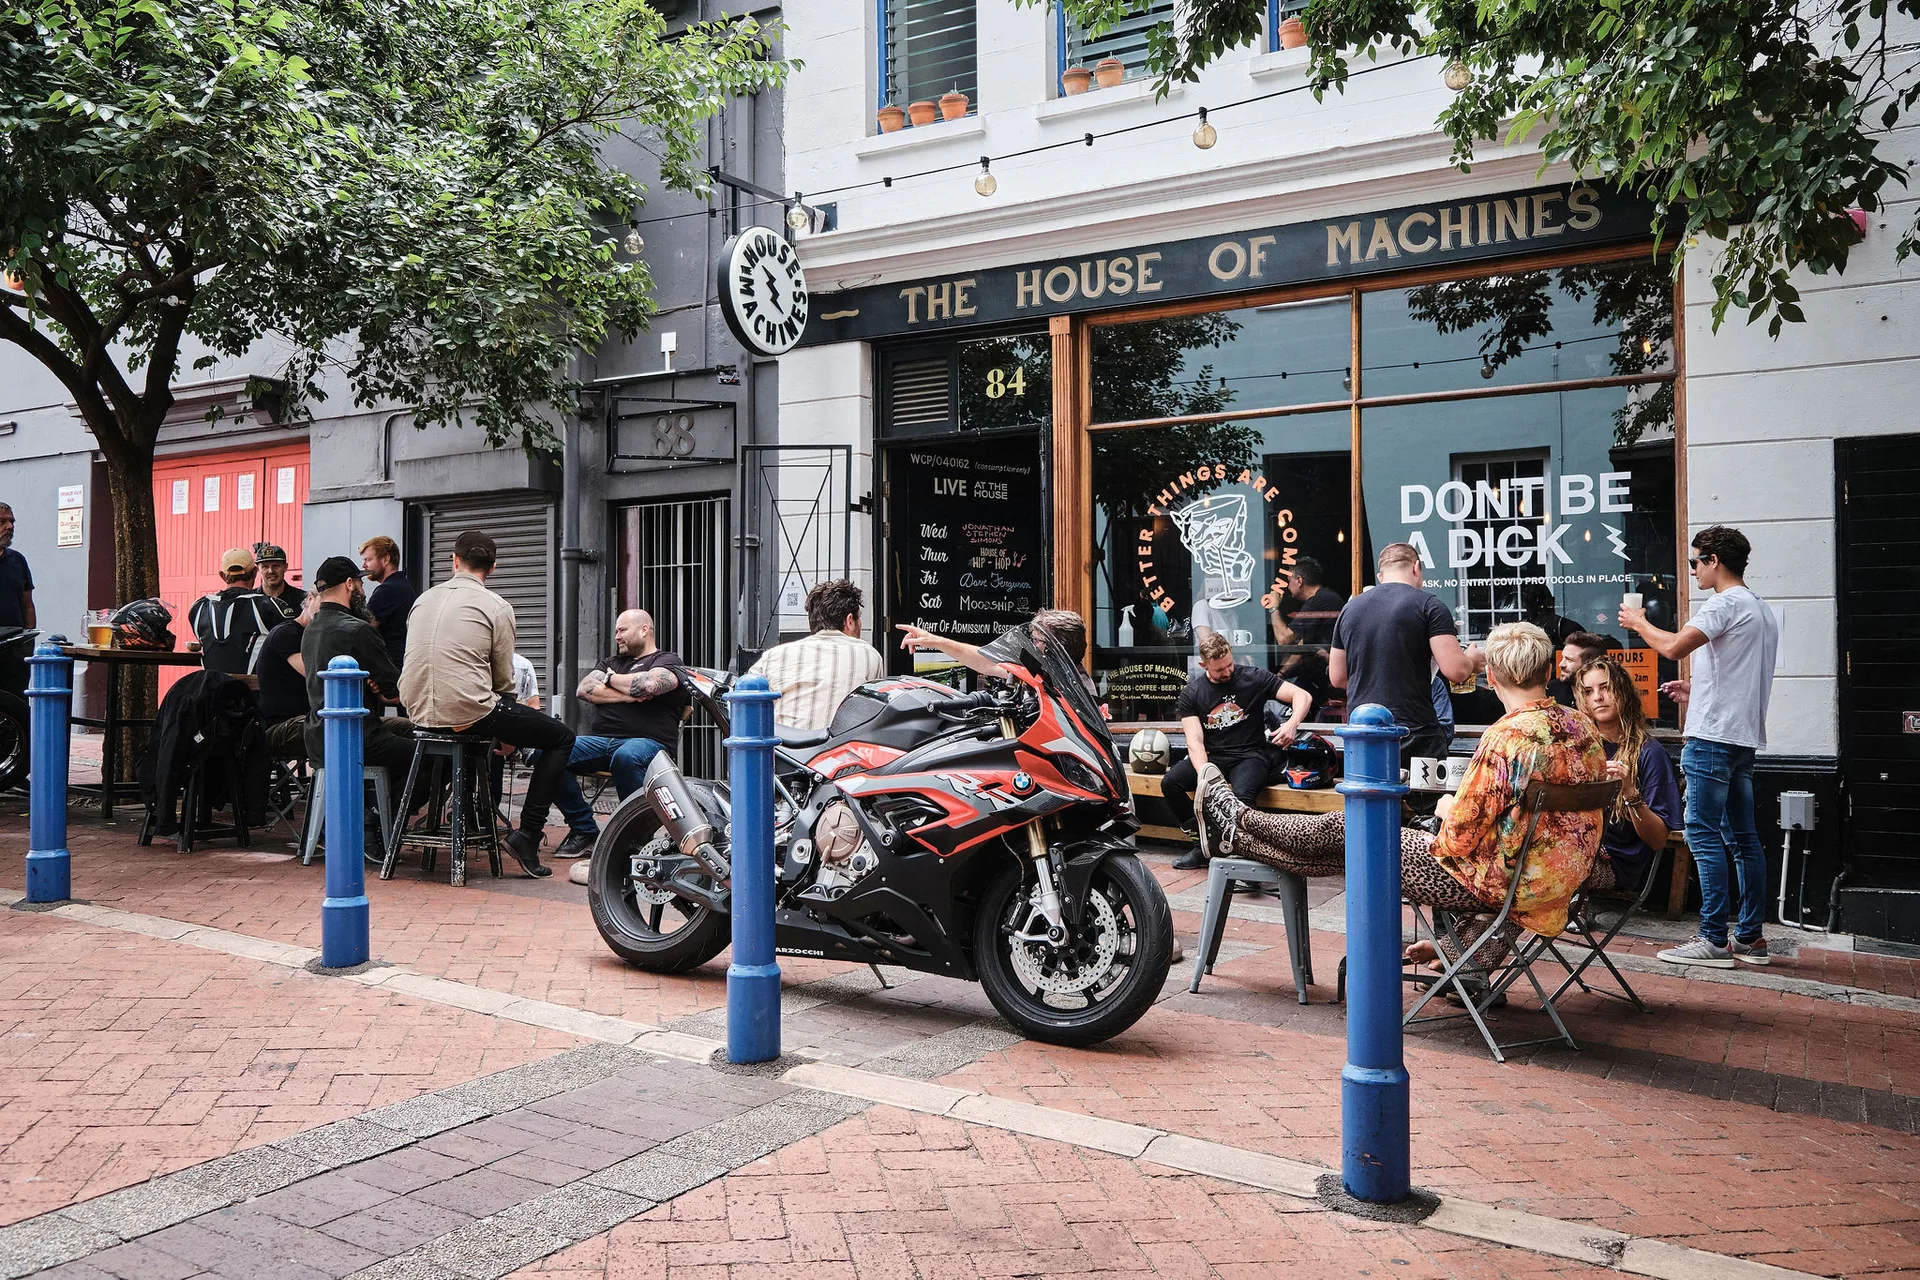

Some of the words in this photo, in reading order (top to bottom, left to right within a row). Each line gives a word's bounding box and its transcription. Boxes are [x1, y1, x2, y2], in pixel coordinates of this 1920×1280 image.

[743, 234, 801, 279] HOUSE
[899, 279, 978, 324] THE
[1016, 252, 1164, 309] HOUSE
[1208, 235, 1276, 282] OF
[1326, 186, 1602, 266] MACHINES
[739, 276, 807, 346] MACHINES
[986, 366, 1026, 399] 84
[652, 414, 696, 456] 88
[910, 453, 970, 469] WCP/040162
[934, 477, 967, 496] LIVE
[974, 481, 986, 489] AT
[988, 482, 1008, 491] THE
[1147, 464, 1227, 517] THINGS
[1236, 469, 1280, 502] ARE
[974, 490, 1008, 500] HOUSE
[1400, 477, 1544, 524] DONT
[1559, 471, 1633, 516] BE
[920, 523, 947, 539] Wed
[962, 523, 1015, 533] JONATHAN
[965, 530, 1007, 538] STEPHEN
[920, 545, 949, 562] Thur
[980, 547, 998, 557] HOUSE
[998, 548, 1008, 557] OF
[1407, 531, 1435, 569] A
[1448, 523, 1574, 569] DICK
[972, 556, 986, 569] HIP
[995, 557, 1011, 570] HOP
[1260, 509, 1298, 609] COMING
[920, 569, 939, 585] Fri
[1138, 528, 1175, 613] BETTER
[960, 572, 988, 588] Dave
[1422, 579, 1442, 588] ASK,
[1444, 579, 1458, 587] NO
[1494, 577, 1523, 586] COVID
[1525, 575, 1584, 585] PROTOCOLS
[1586, 575, 1596, 583] IN
[1598, 574, 1634, 583] PLACE.
[919, 593, 943, 609] Sat
[917, 617, 938, 633] RIGHT
[939, 619, 950, 633] OF
[951, 620, 991, 634] ADMISSION
[1610, 652, 1644, 663] HOURS
[1107, 669, 1119, 681] THE
[1119, 664, 1143, 675] HOUSE
[1144, 664, 1154, 672] OF
[1155, 664, 1191, 682] MACHINES
[775, 947, 824, 956] ARZOCCHI
